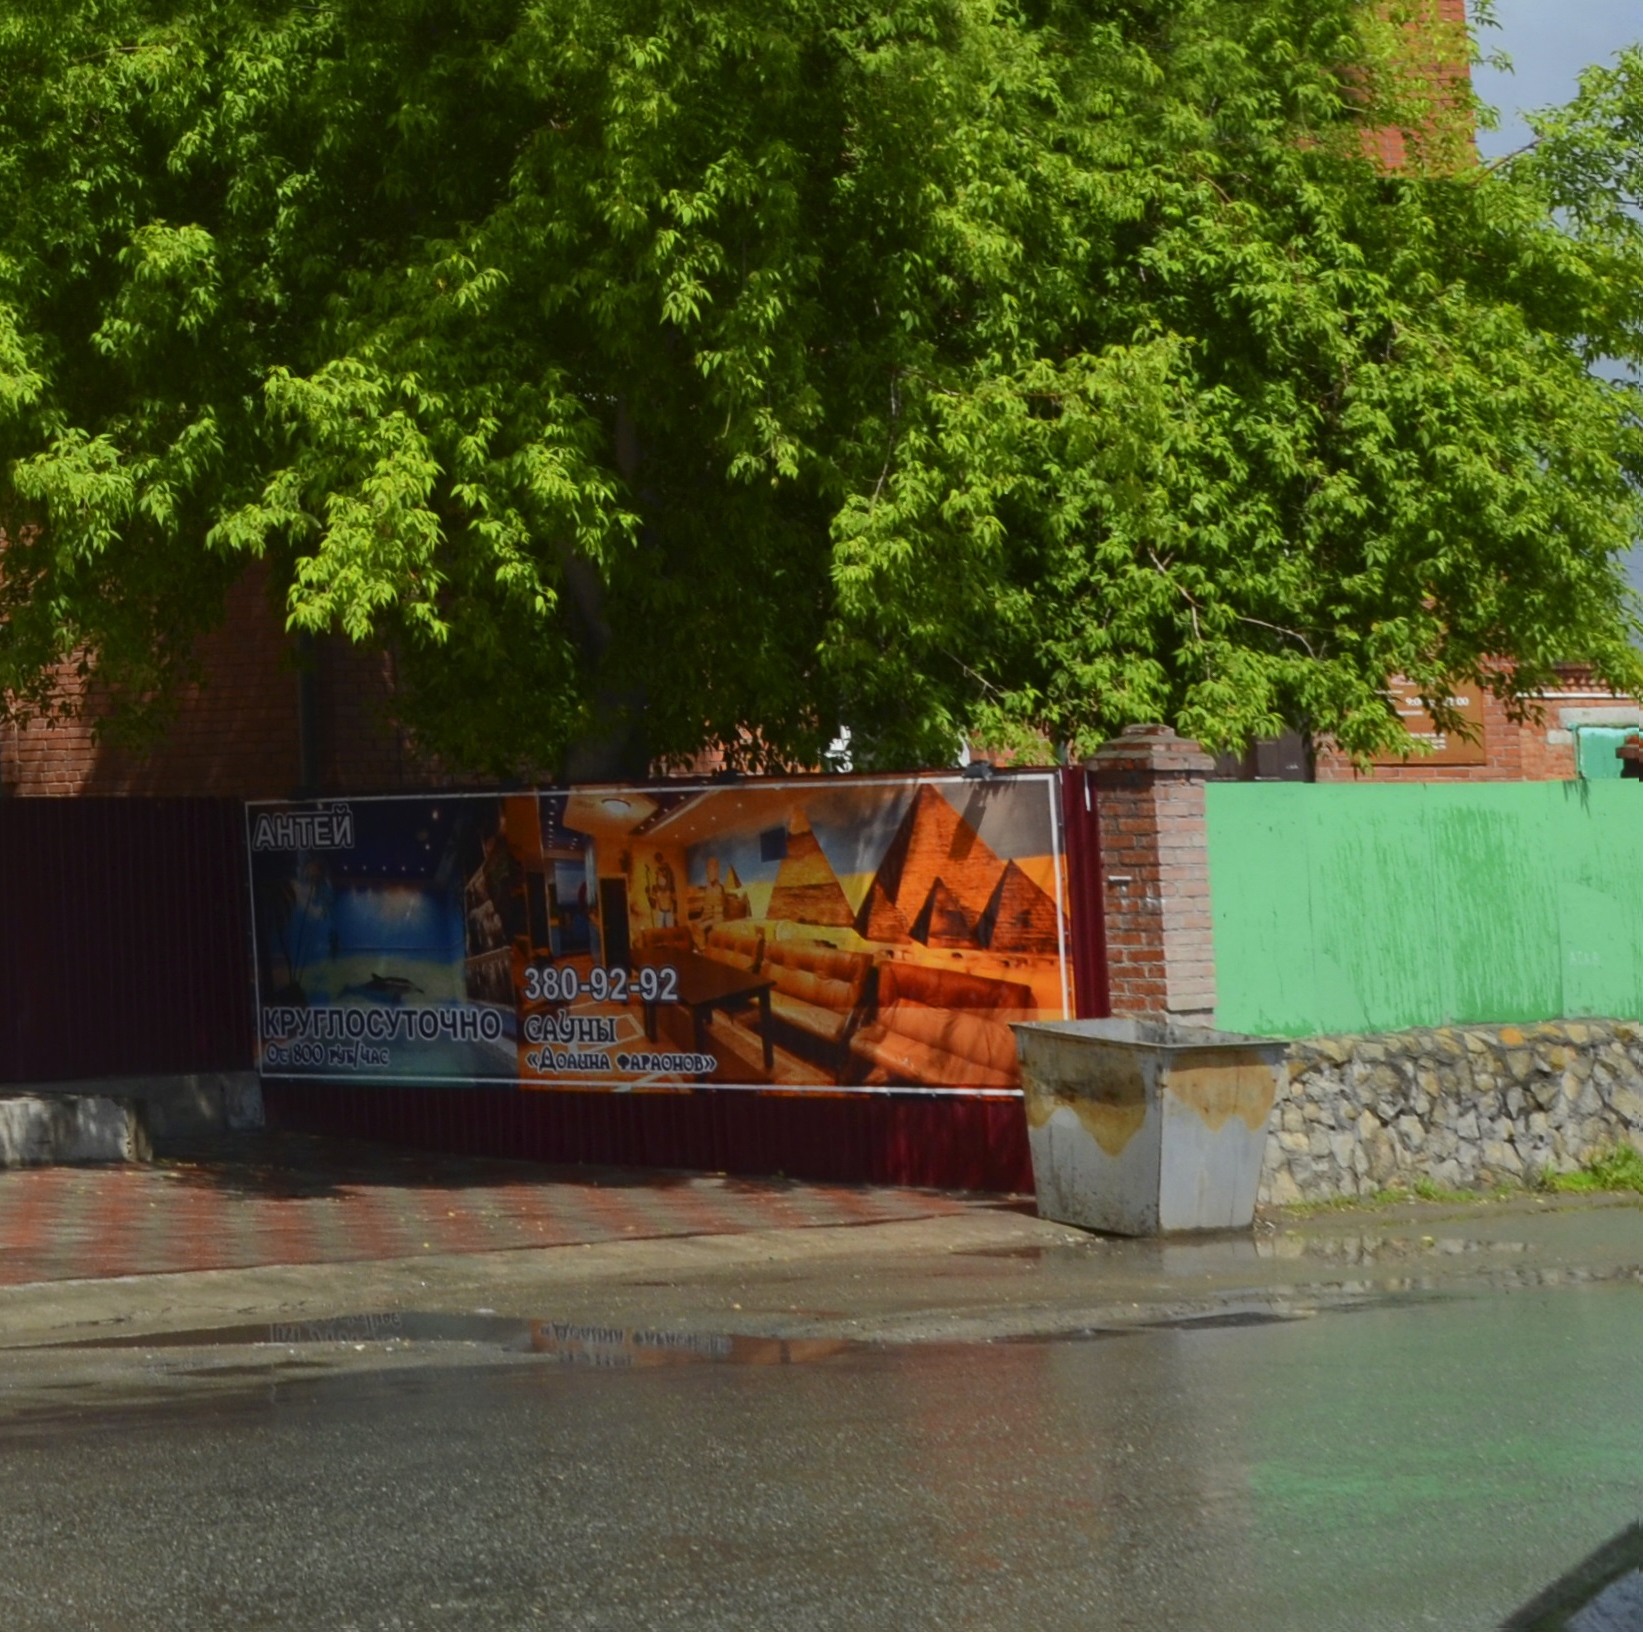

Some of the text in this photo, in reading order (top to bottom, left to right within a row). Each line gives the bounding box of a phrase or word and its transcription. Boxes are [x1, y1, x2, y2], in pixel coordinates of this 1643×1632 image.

[254, 804, 353, 848] АНТЕЙ
[523, 966, 679, 1002] 380-92-92
[264, 1007, 502, 1042] КРУГЛОСУТОЧНО
[293, 1043, 324, 1065] 800
